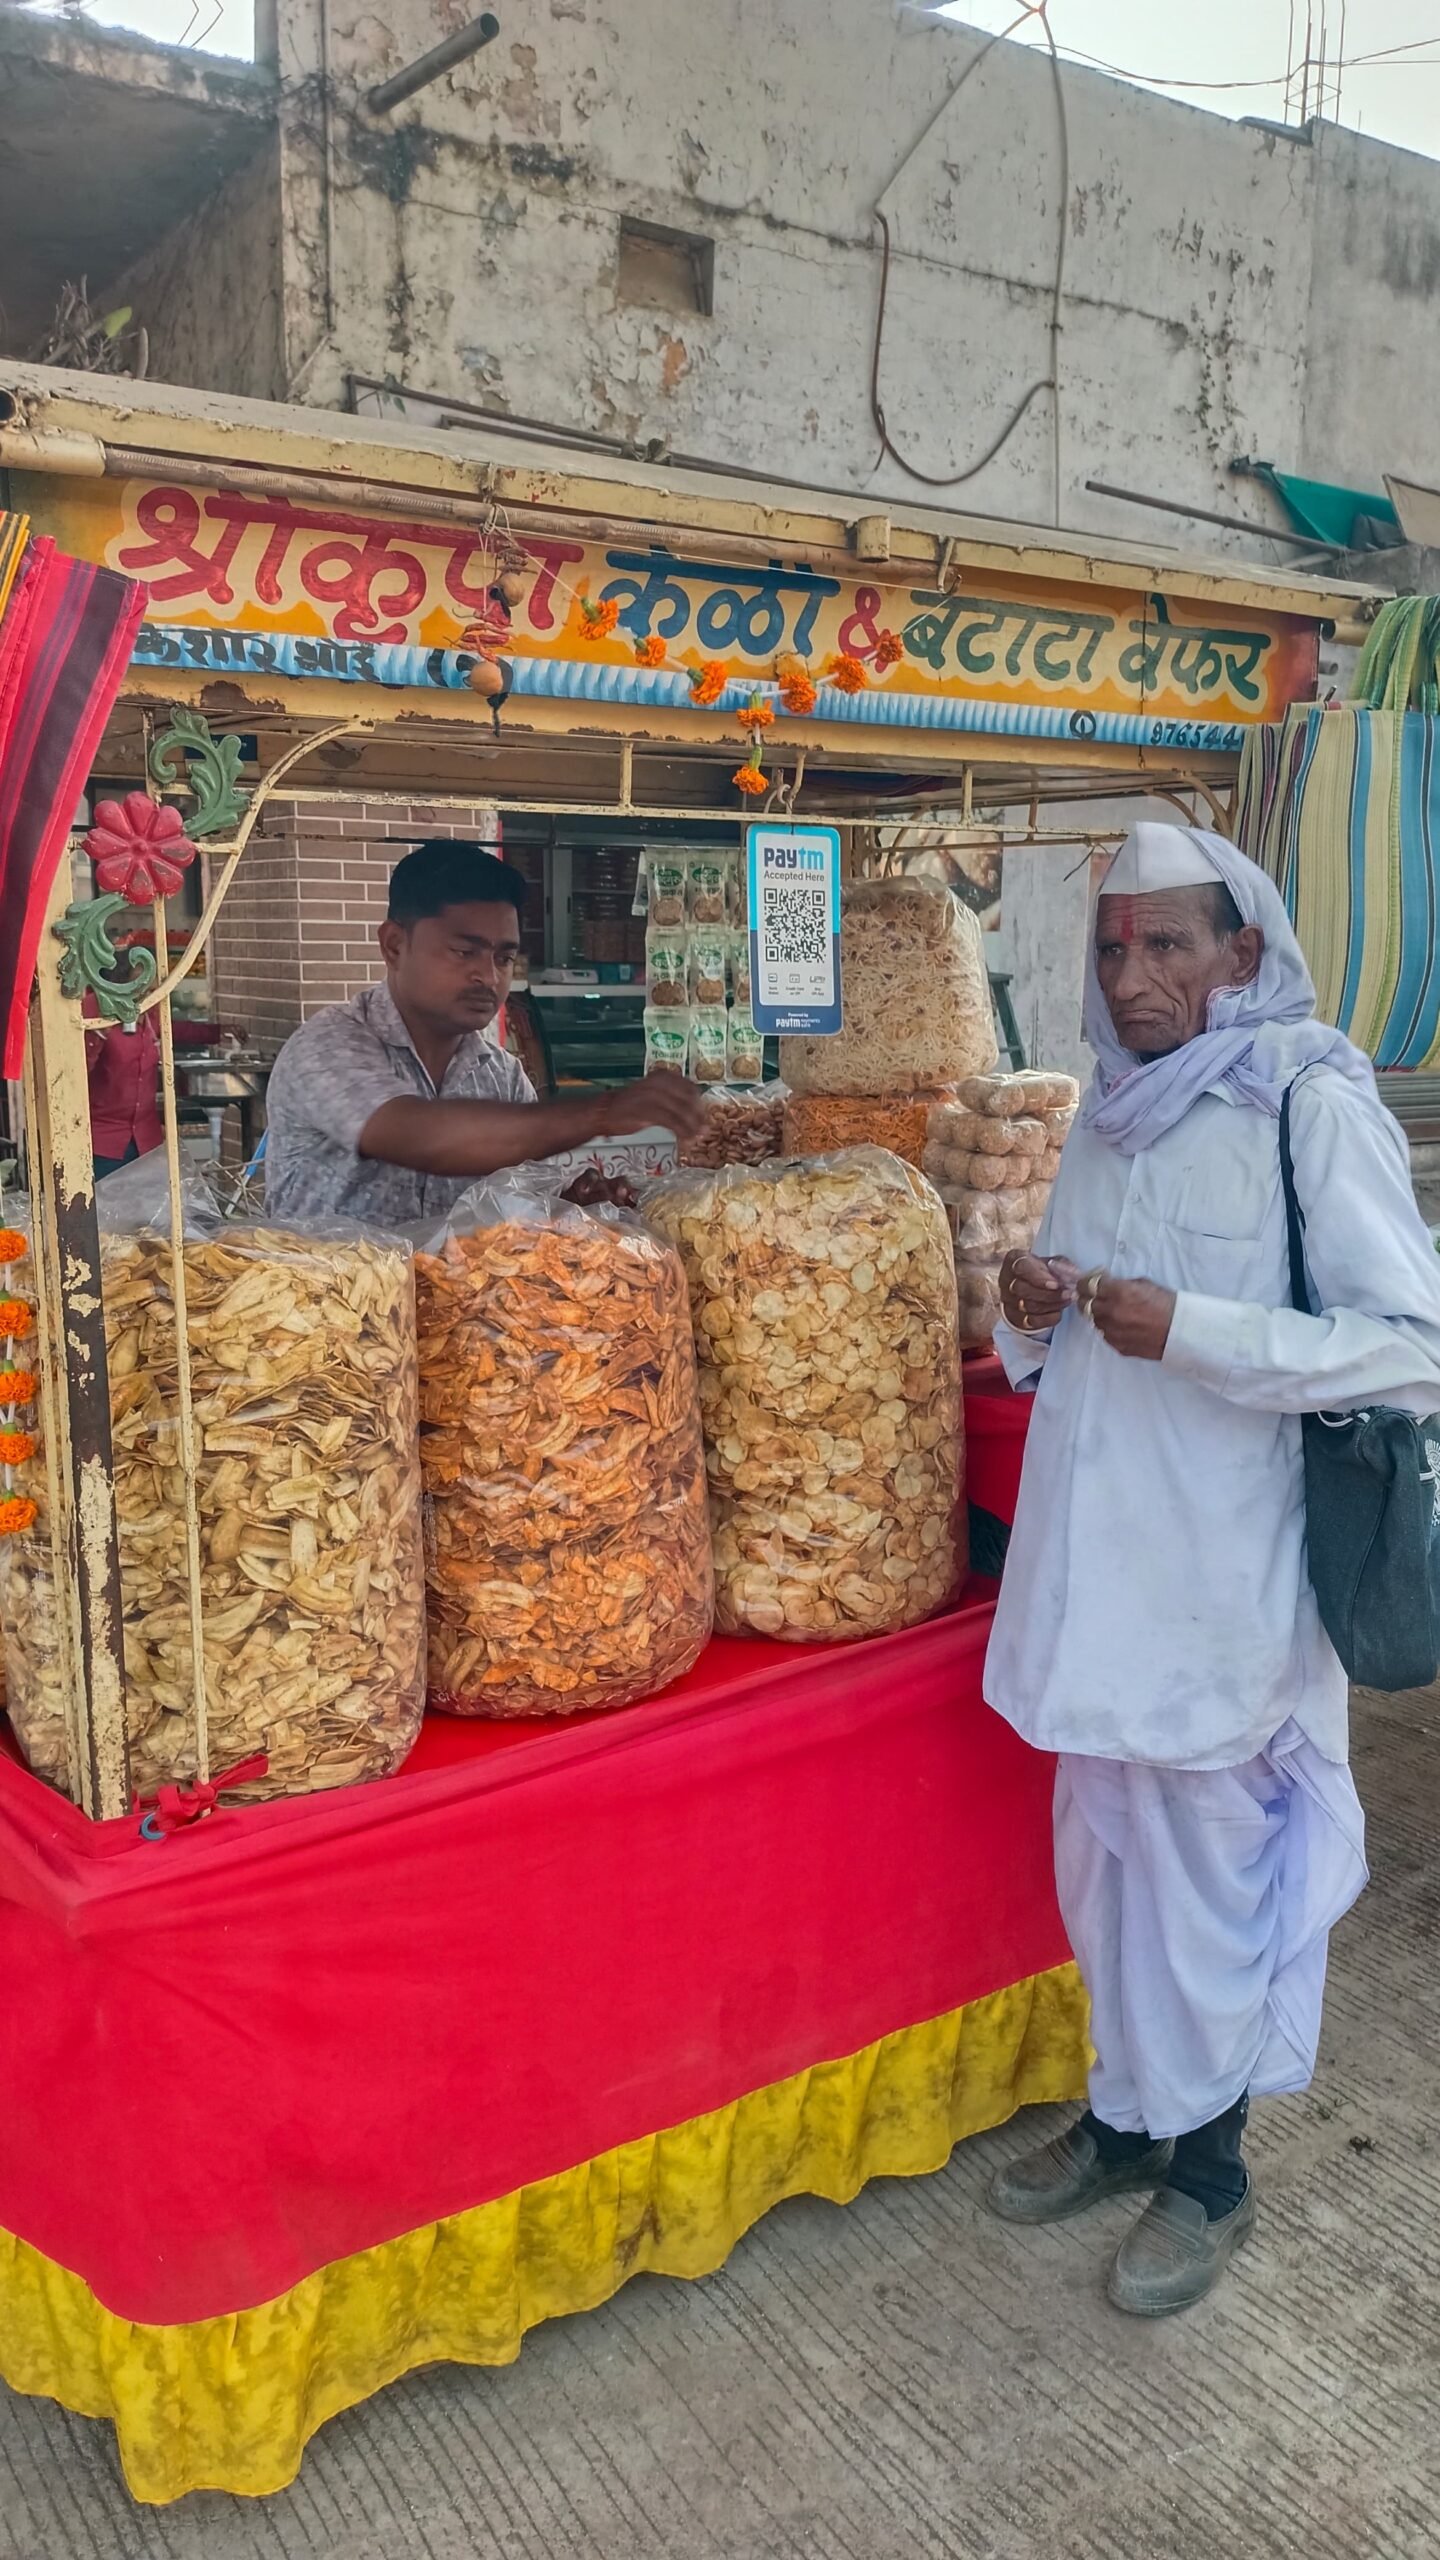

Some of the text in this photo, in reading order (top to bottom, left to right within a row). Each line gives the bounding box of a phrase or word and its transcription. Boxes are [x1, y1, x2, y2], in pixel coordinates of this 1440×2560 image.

[838, 586, 902, 674] &
[902, 588, 1115, 683] बटाटा
[1118, 591, 1272, 701] वेफर
[1150, 721, 1247, 750] 976544
[763, 870, 825, 882] Accepted Here
